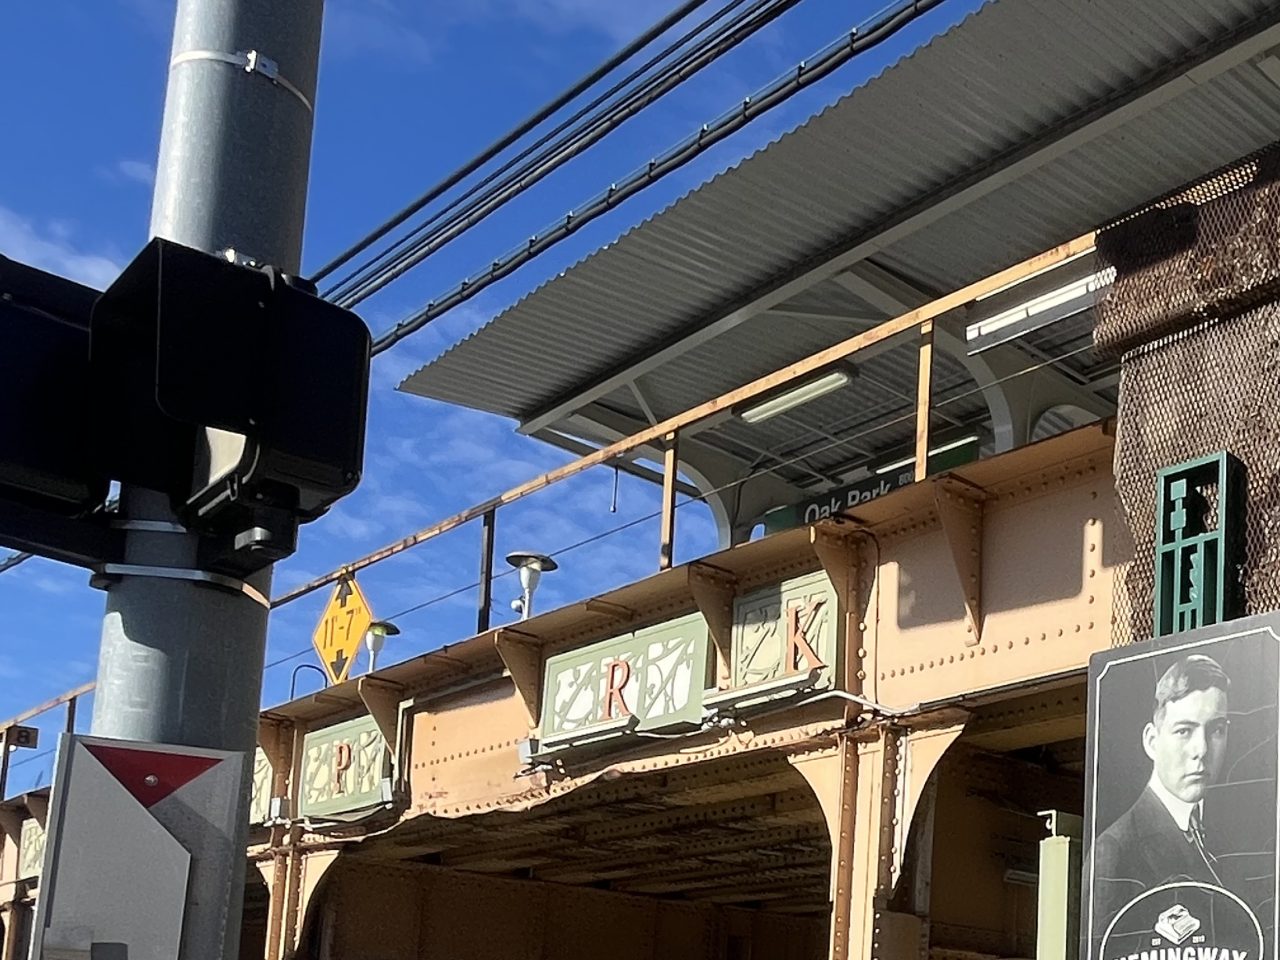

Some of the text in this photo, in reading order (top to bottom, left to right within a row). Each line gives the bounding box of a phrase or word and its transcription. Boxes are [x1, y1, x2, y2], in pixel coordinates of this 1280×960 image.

[334, 600, 830, 795] P R K
